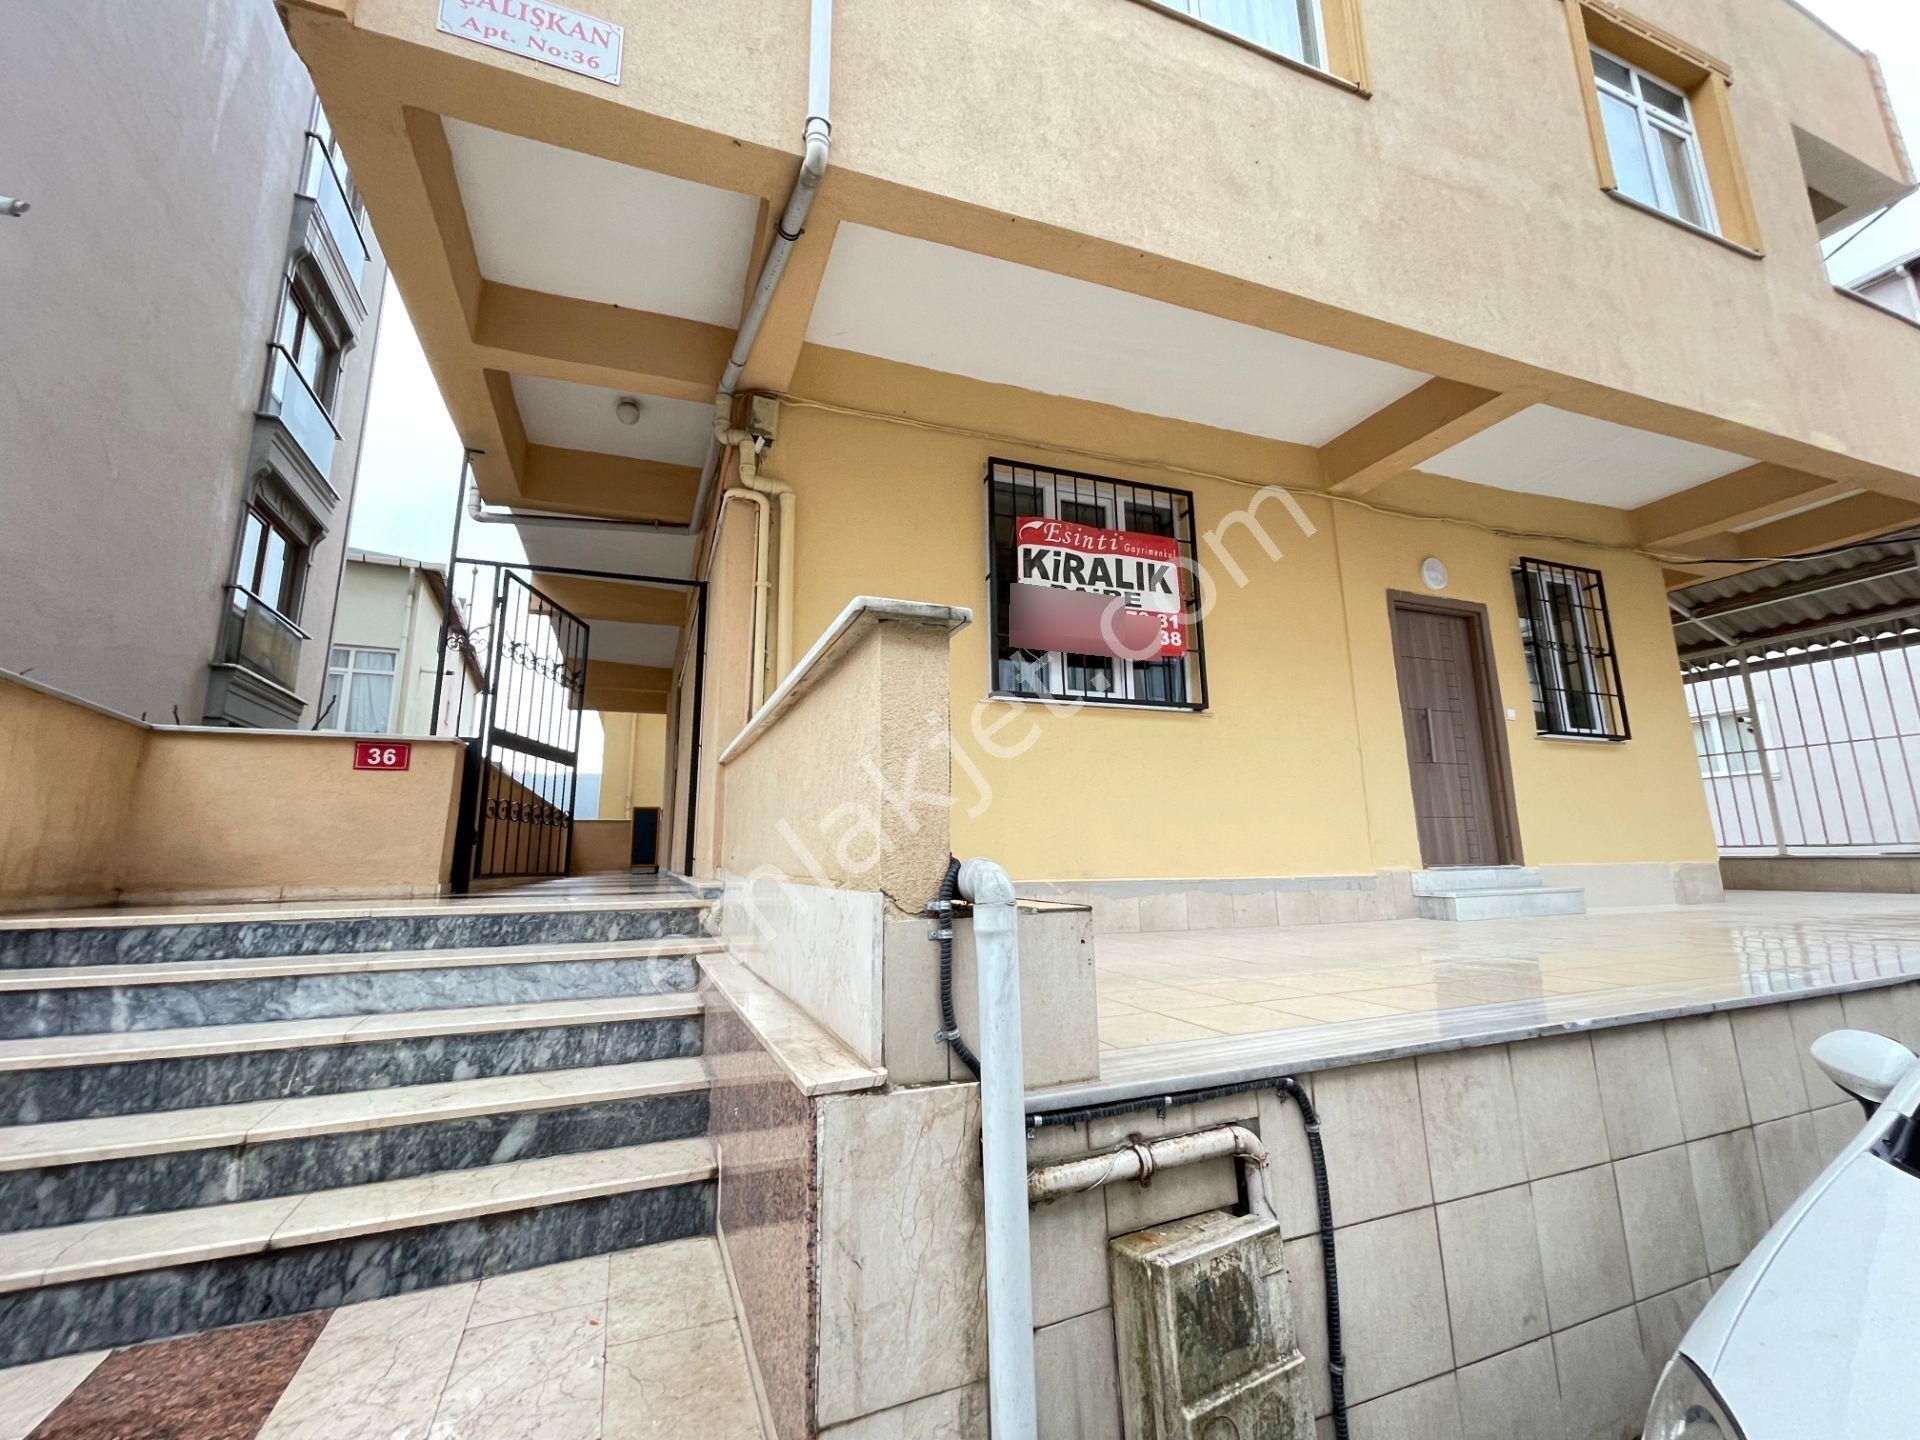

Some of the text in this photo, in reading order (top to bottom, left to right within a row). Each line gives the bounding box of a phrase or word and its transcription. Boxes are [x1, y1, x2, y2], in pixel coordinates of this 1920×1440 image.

[460, 16, 601, 70] Apt. No:36
[367, 747, 397, 765] 36
